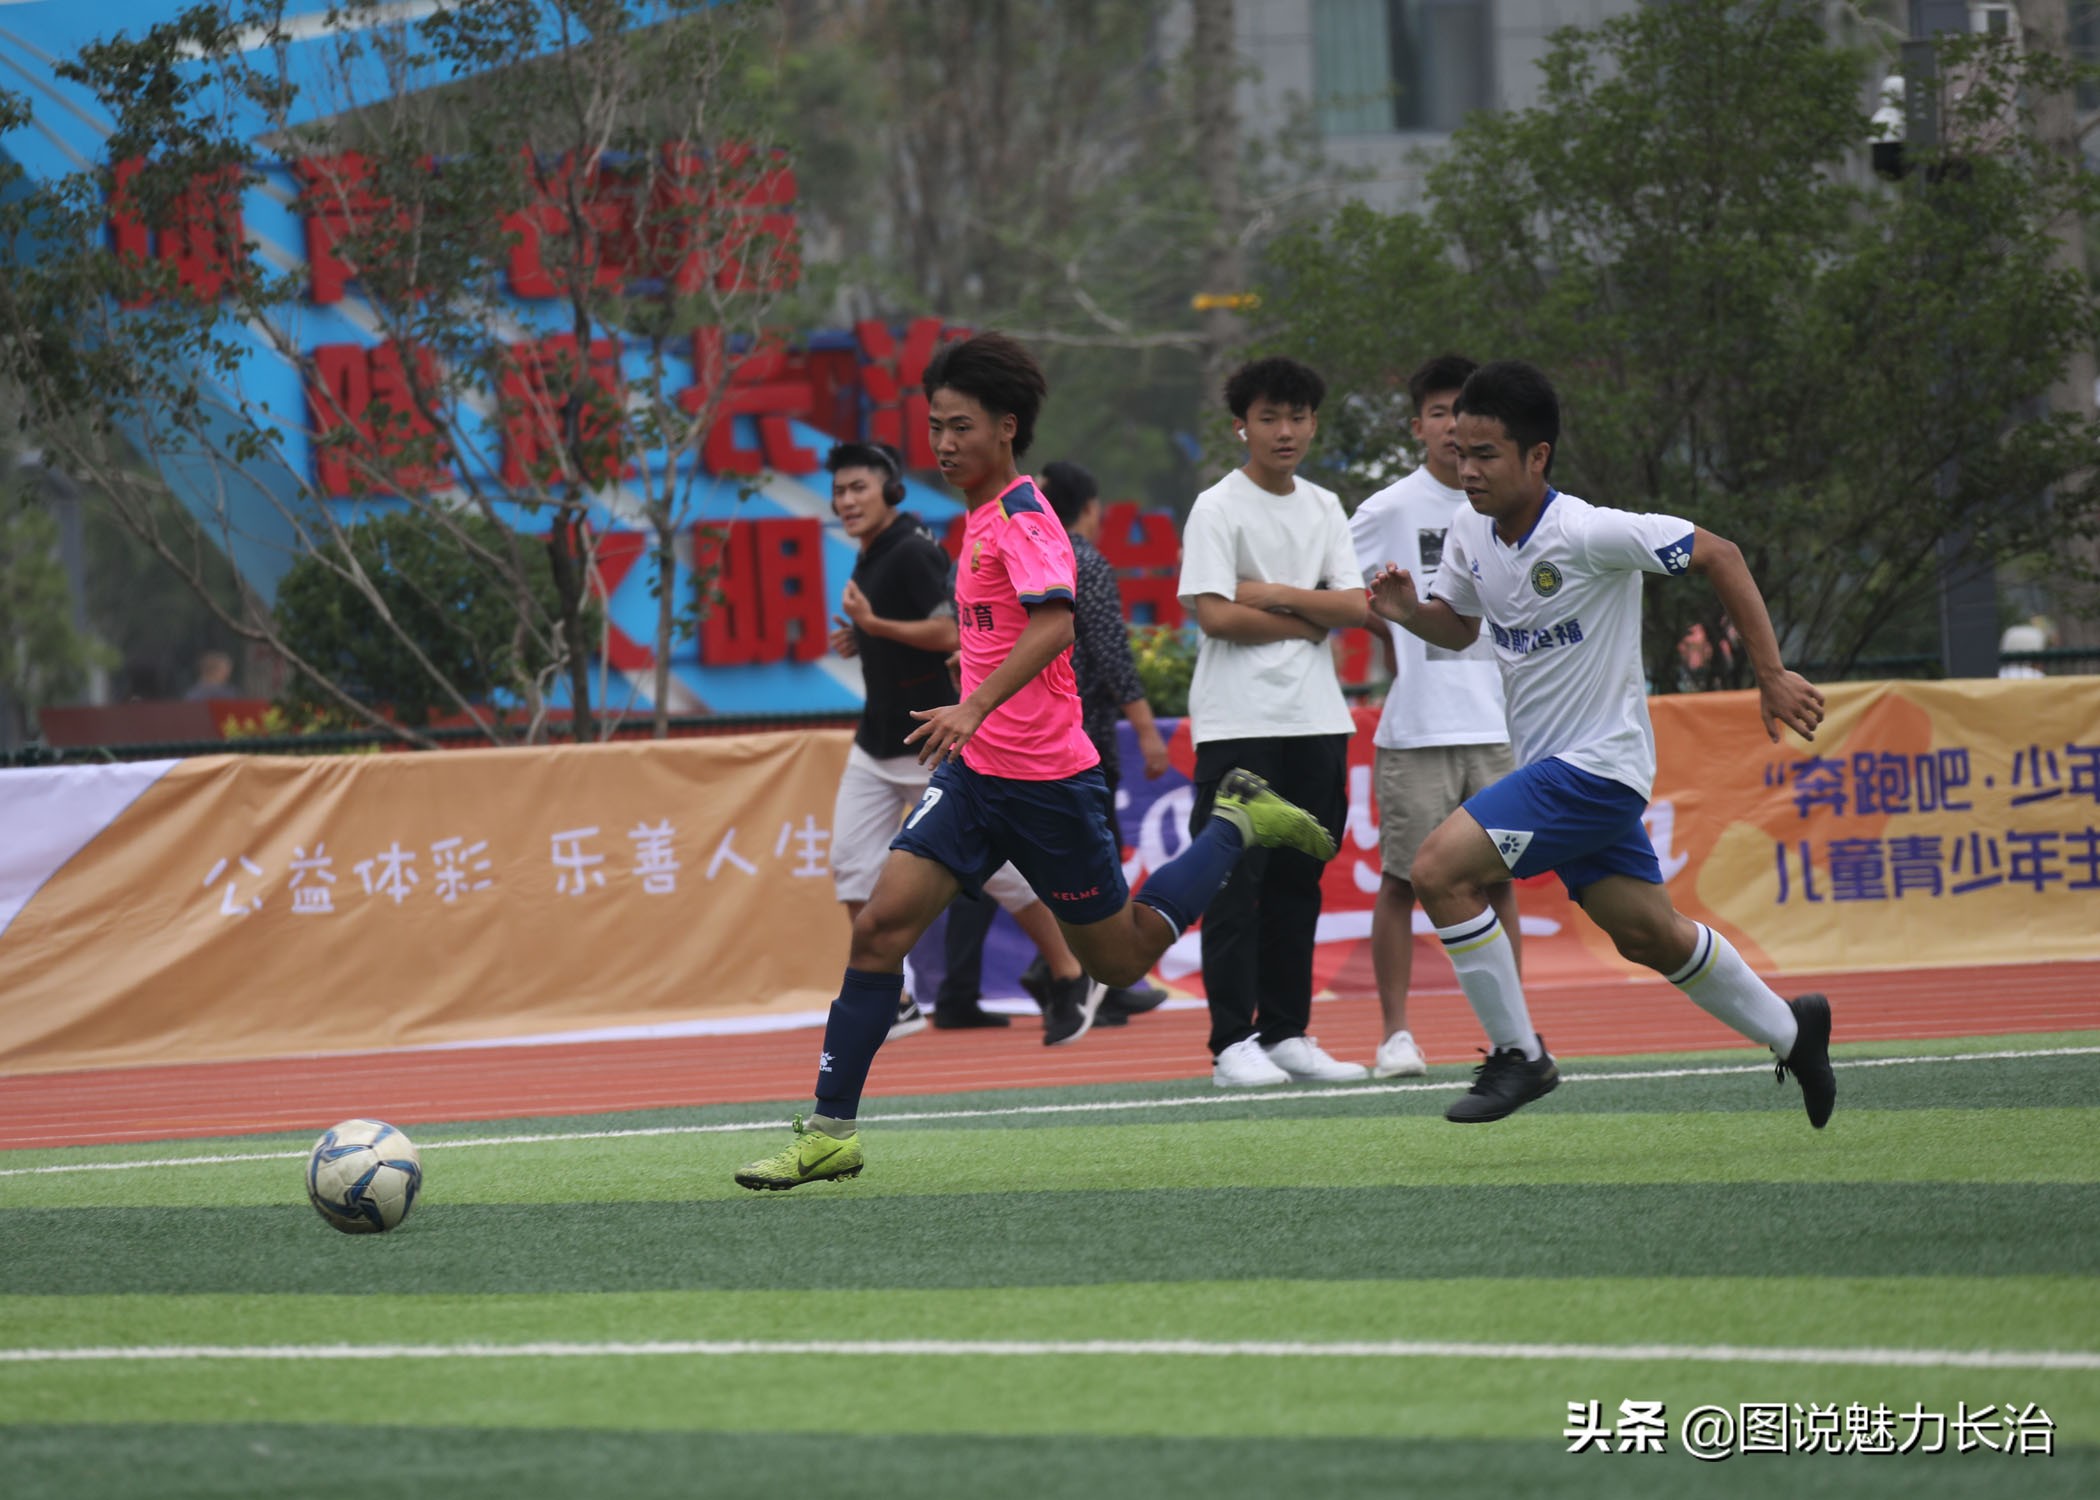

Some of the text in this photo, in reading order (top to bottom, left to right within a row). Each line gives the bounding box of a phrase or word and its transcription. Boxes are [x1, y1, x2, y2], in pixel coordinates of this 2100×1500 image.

[906, 786, 943, 829] 7
[203, 815, 830, 916] 公益体彩 乐善人生
